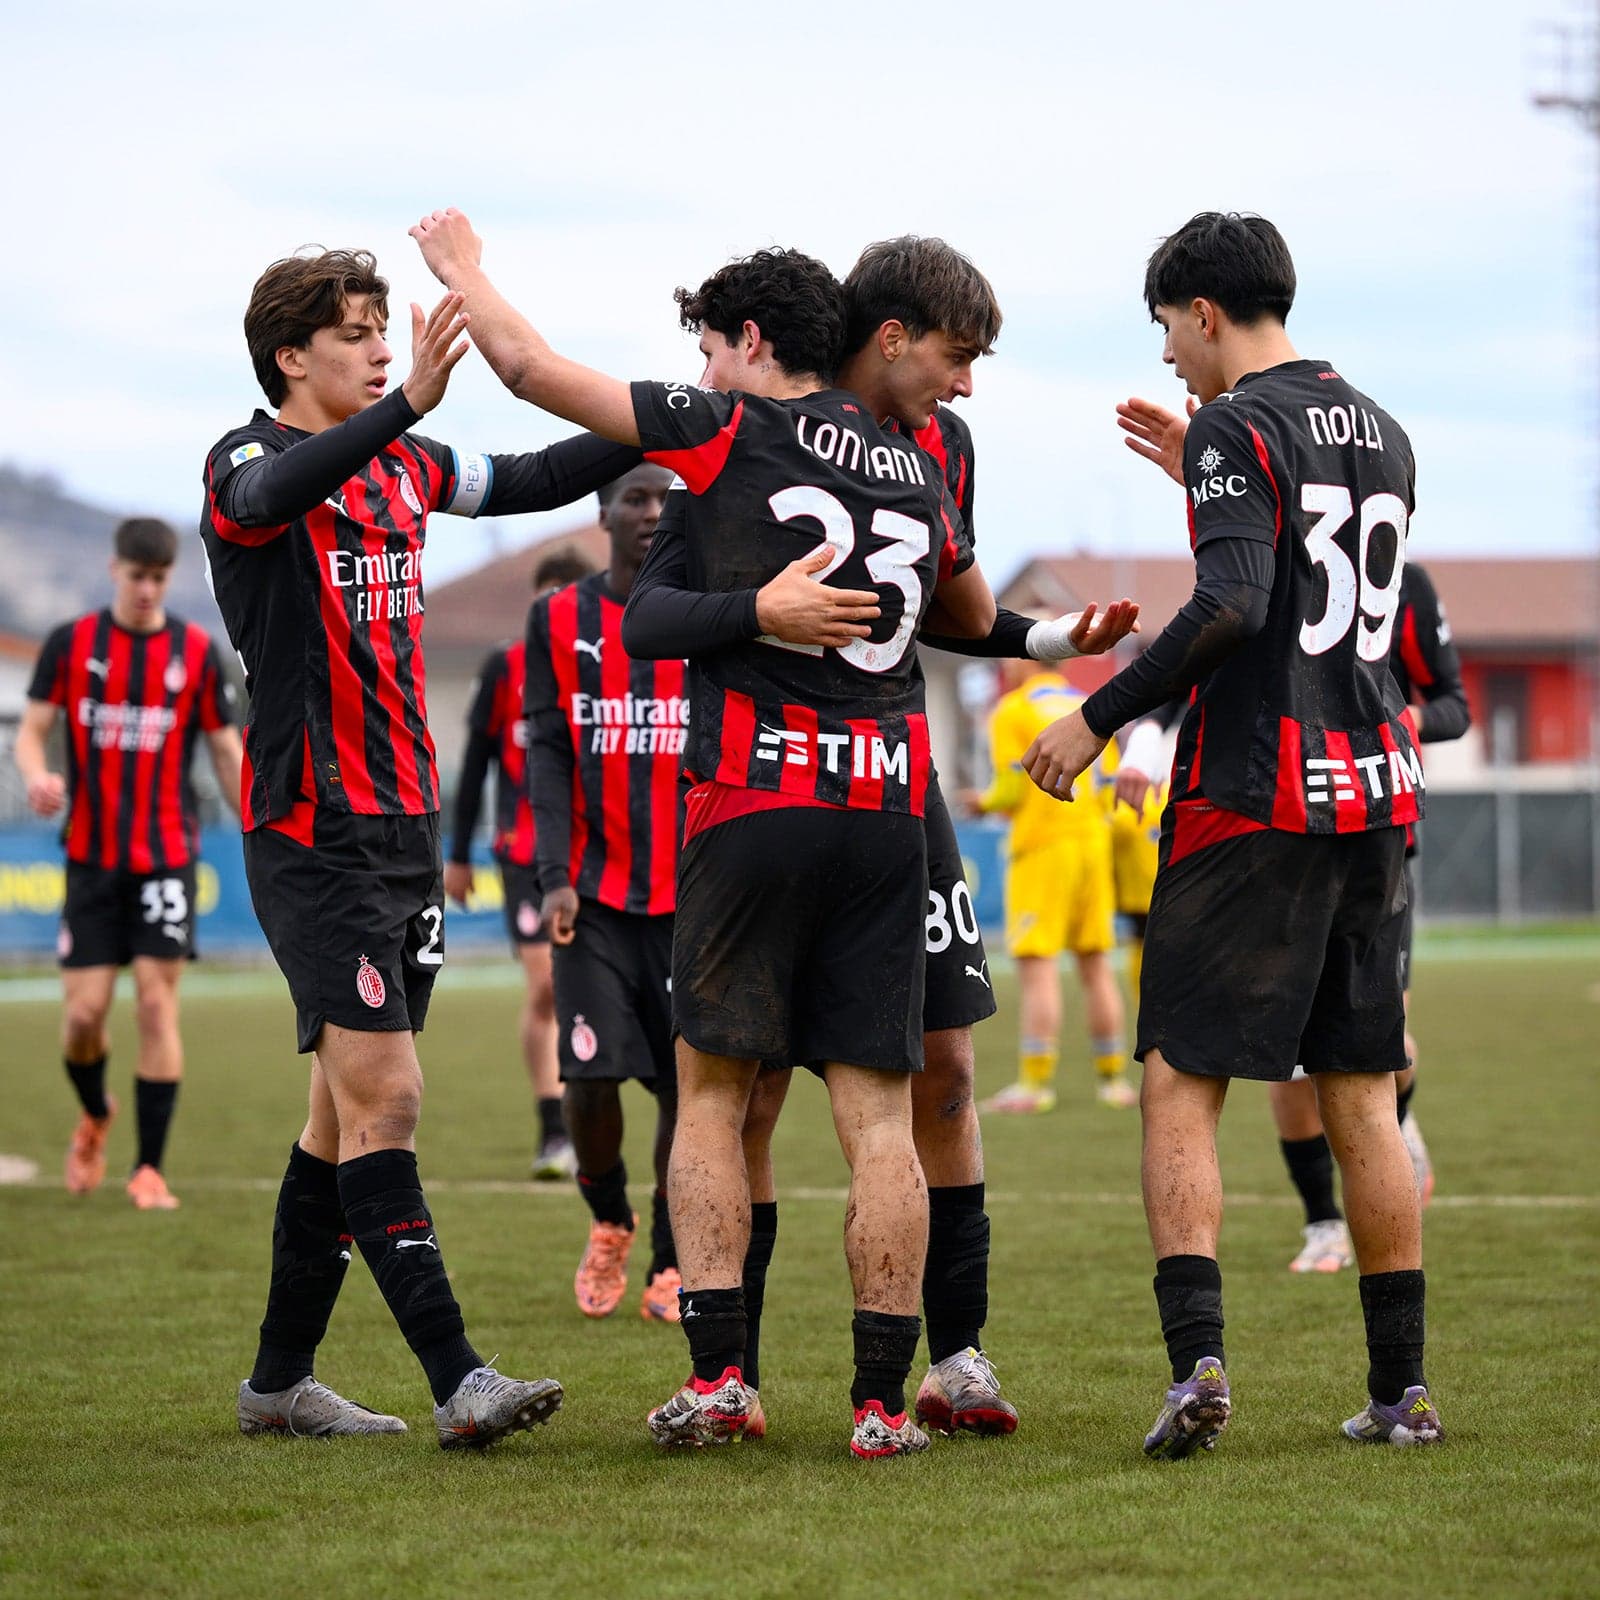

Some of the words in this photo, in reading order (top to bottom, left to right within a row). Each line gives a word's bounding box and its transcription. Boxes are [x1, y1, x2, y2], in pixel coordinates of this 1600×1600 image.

[1305, 404, 1384, 452] NOLLI
[1191, 474, 1249, 510] MSC
[754, 485, 930, 673] 23
[1299, 483, 1408, 663] 39
[357, 591, 383, 622] FLY
[591, 728, 622, 755] FLY
[817, 733, 908, 785] TIM
[1354, 747, 1426, 799] TIM
[417, 905, 444, 965] 2
[925, 880, 979, 953] 80
